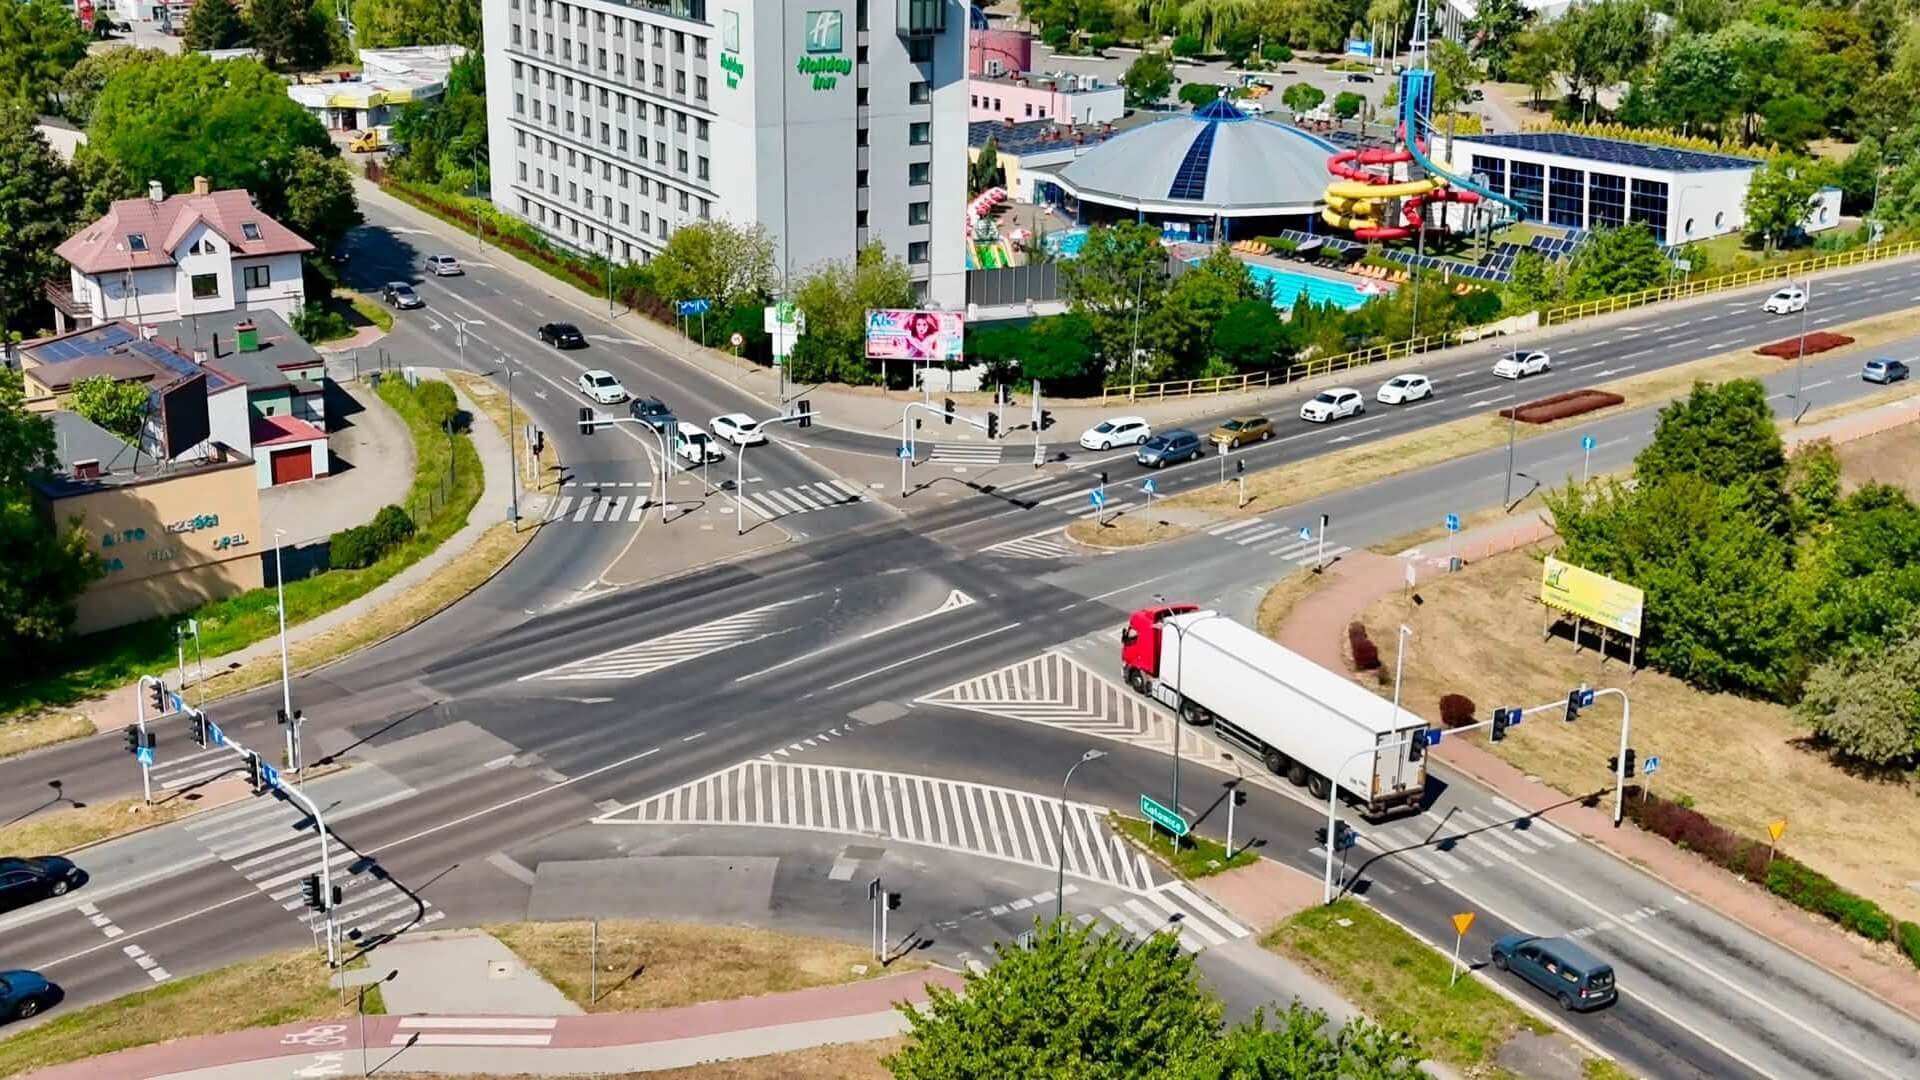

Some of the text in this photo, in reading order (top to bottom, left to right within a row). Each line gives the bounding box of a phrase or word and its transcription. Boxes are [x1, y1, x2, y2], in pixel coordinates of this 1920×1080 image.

[797, 56, 852, 76] Holiday
[812, 73, 837, 91] Inn
[1143, 800, 1181, 831] Katowice
